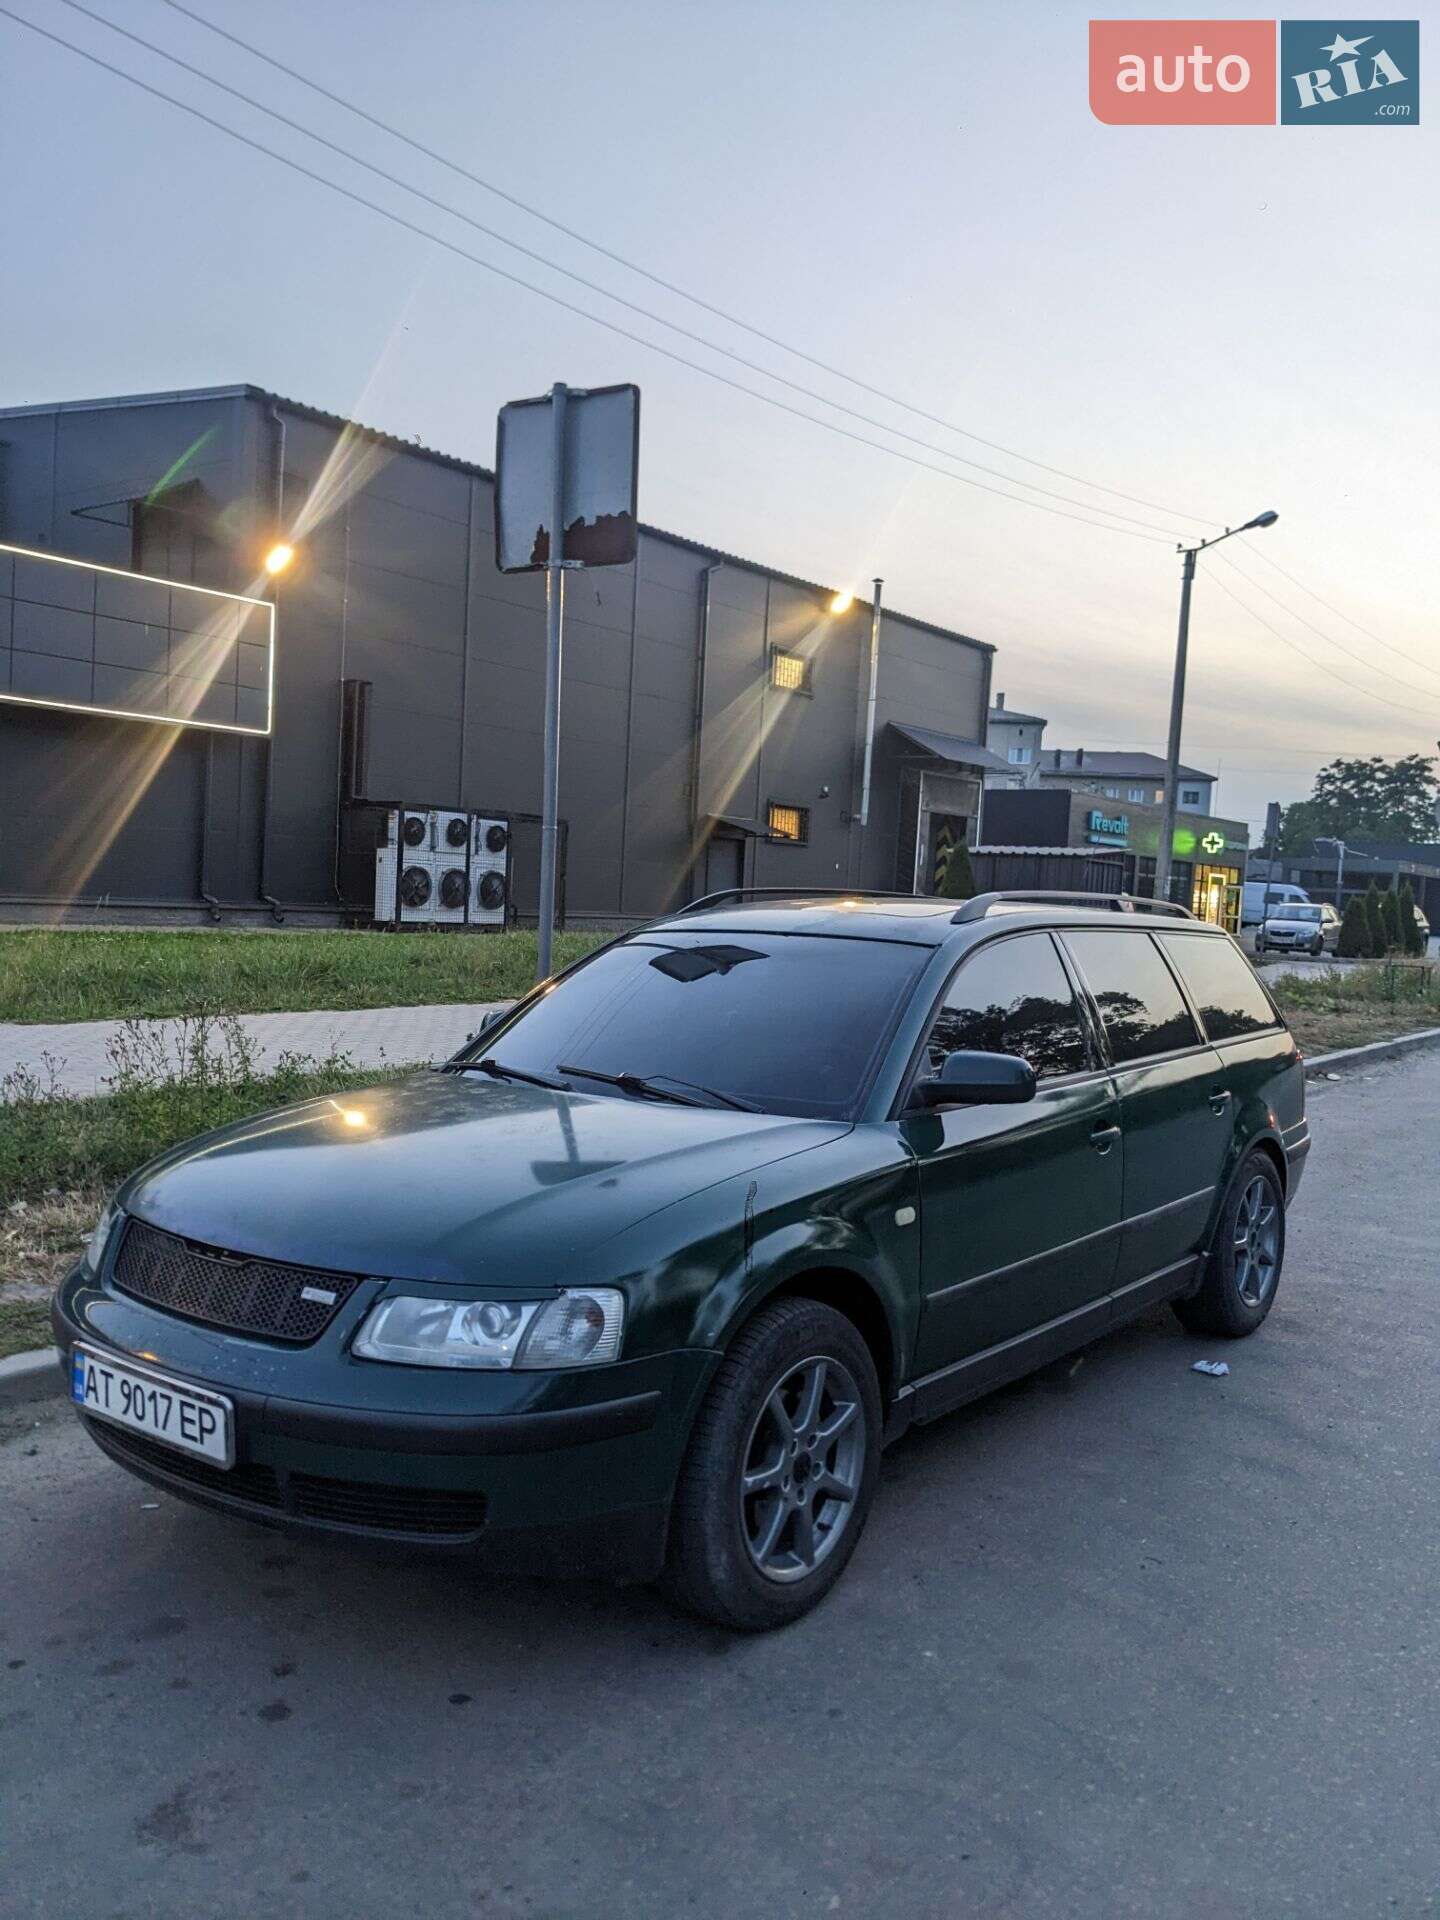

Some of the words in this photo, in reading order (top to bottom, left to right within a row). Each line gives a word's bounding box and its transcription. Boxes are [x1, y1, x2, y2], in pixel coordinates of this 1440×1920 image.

[85, 1365, 114, 1408] AT
[120, 1379, 173, 1431] 9017
[179, 1401, 216, 1445] EP
